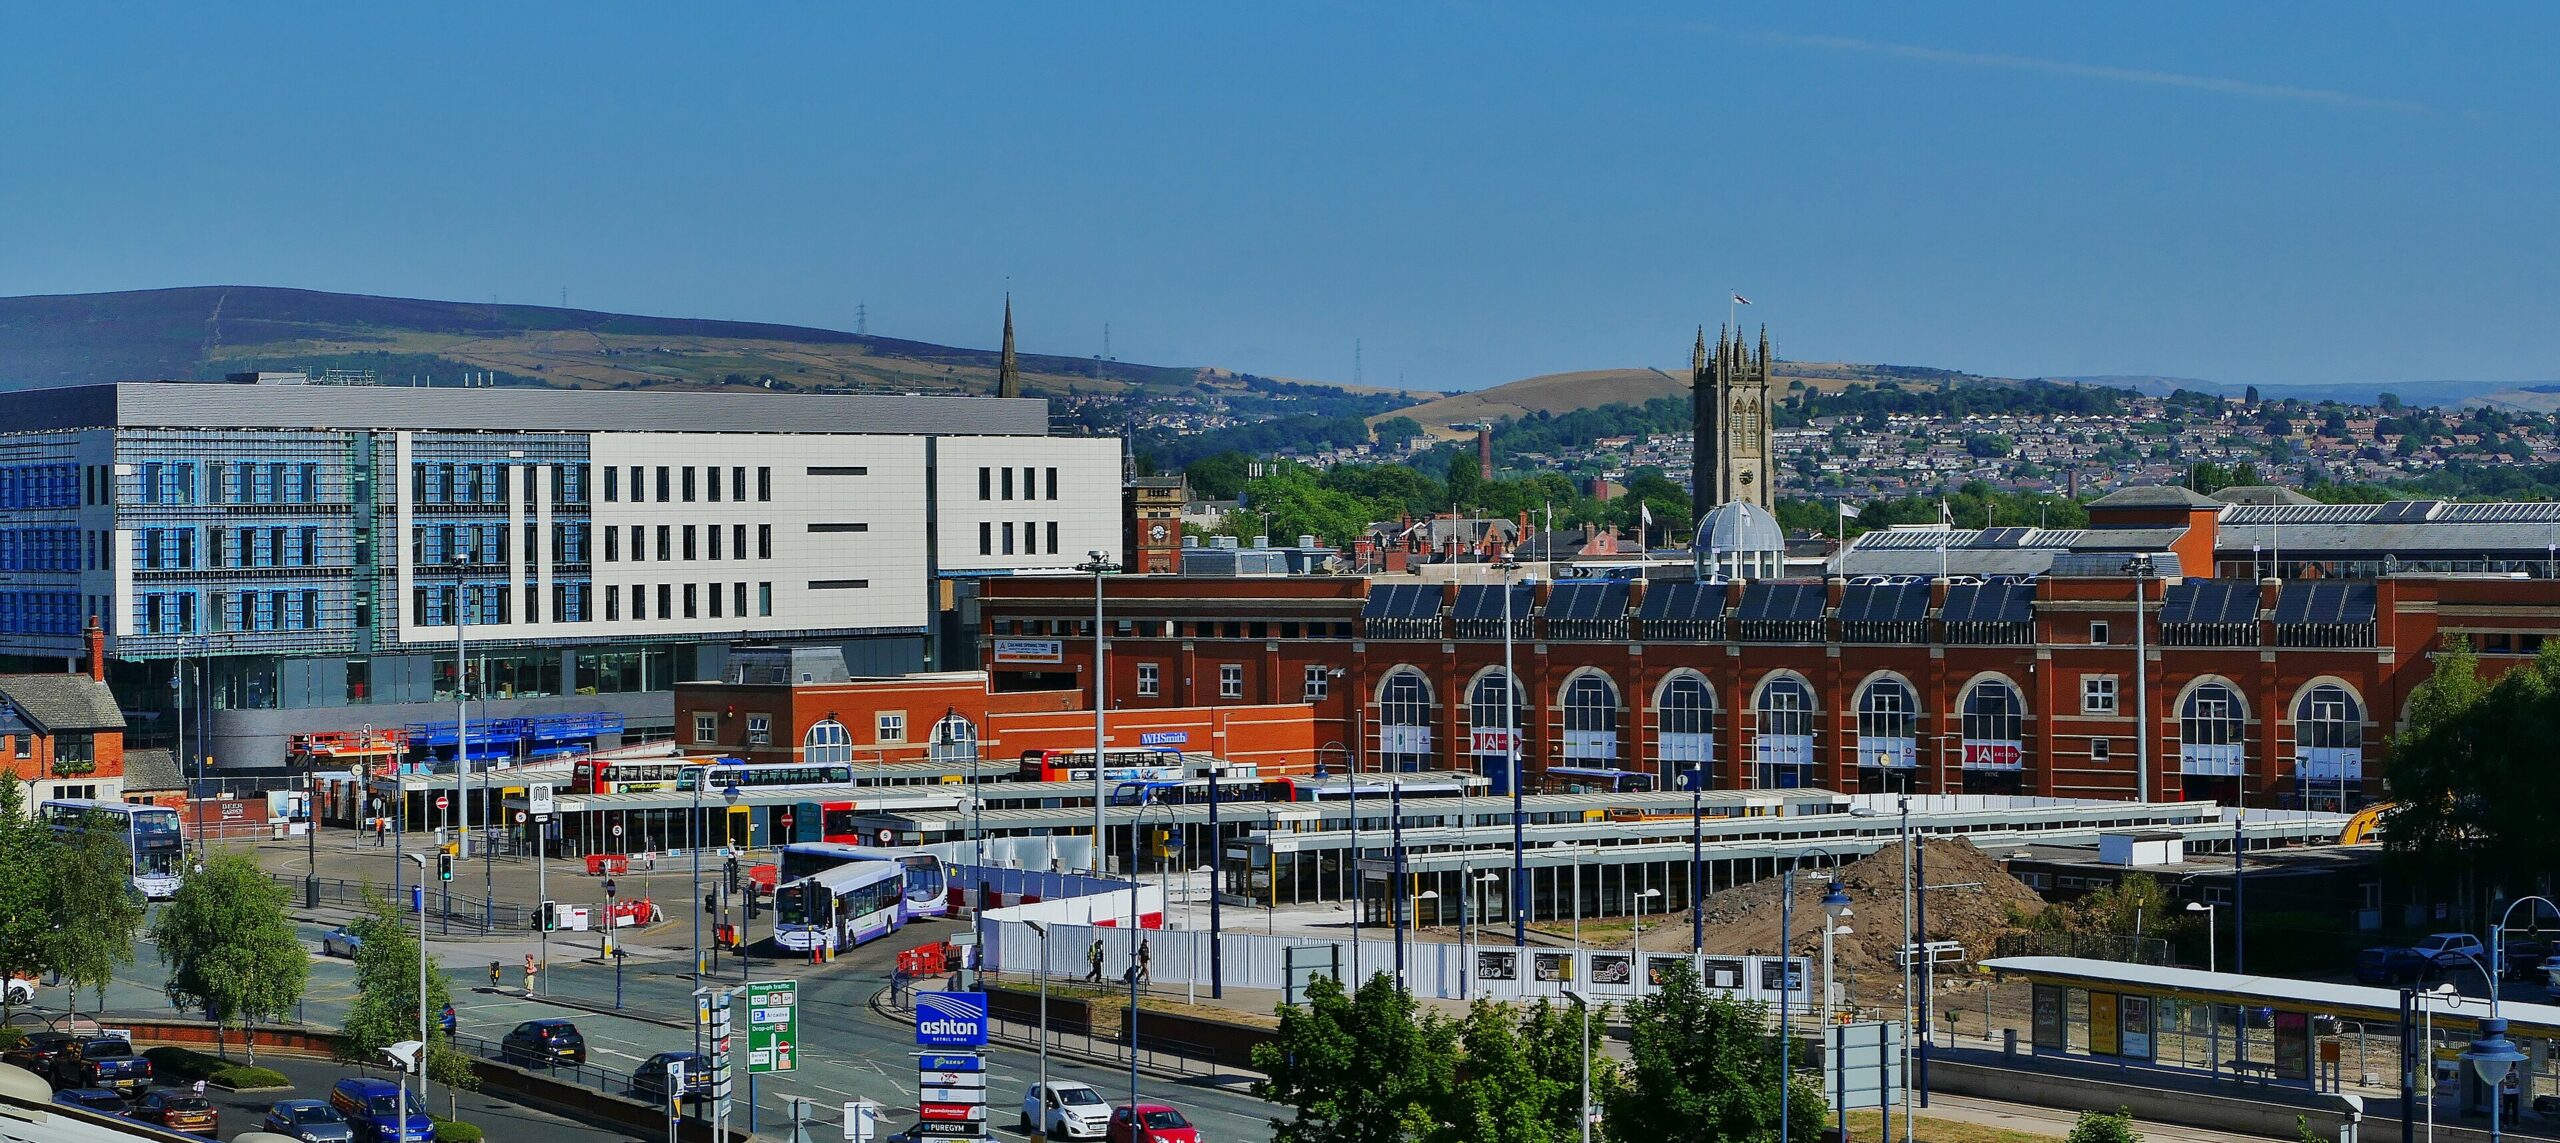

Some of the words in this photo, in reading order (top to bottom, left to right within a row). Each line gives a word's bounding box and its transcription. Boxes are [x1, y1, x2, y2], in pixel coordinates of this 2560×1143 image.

[1142, 733, 1185, 743] WHSmith
[1979, 747, 1991, 761] A
[920, 1019, 978, 1035] ashton
